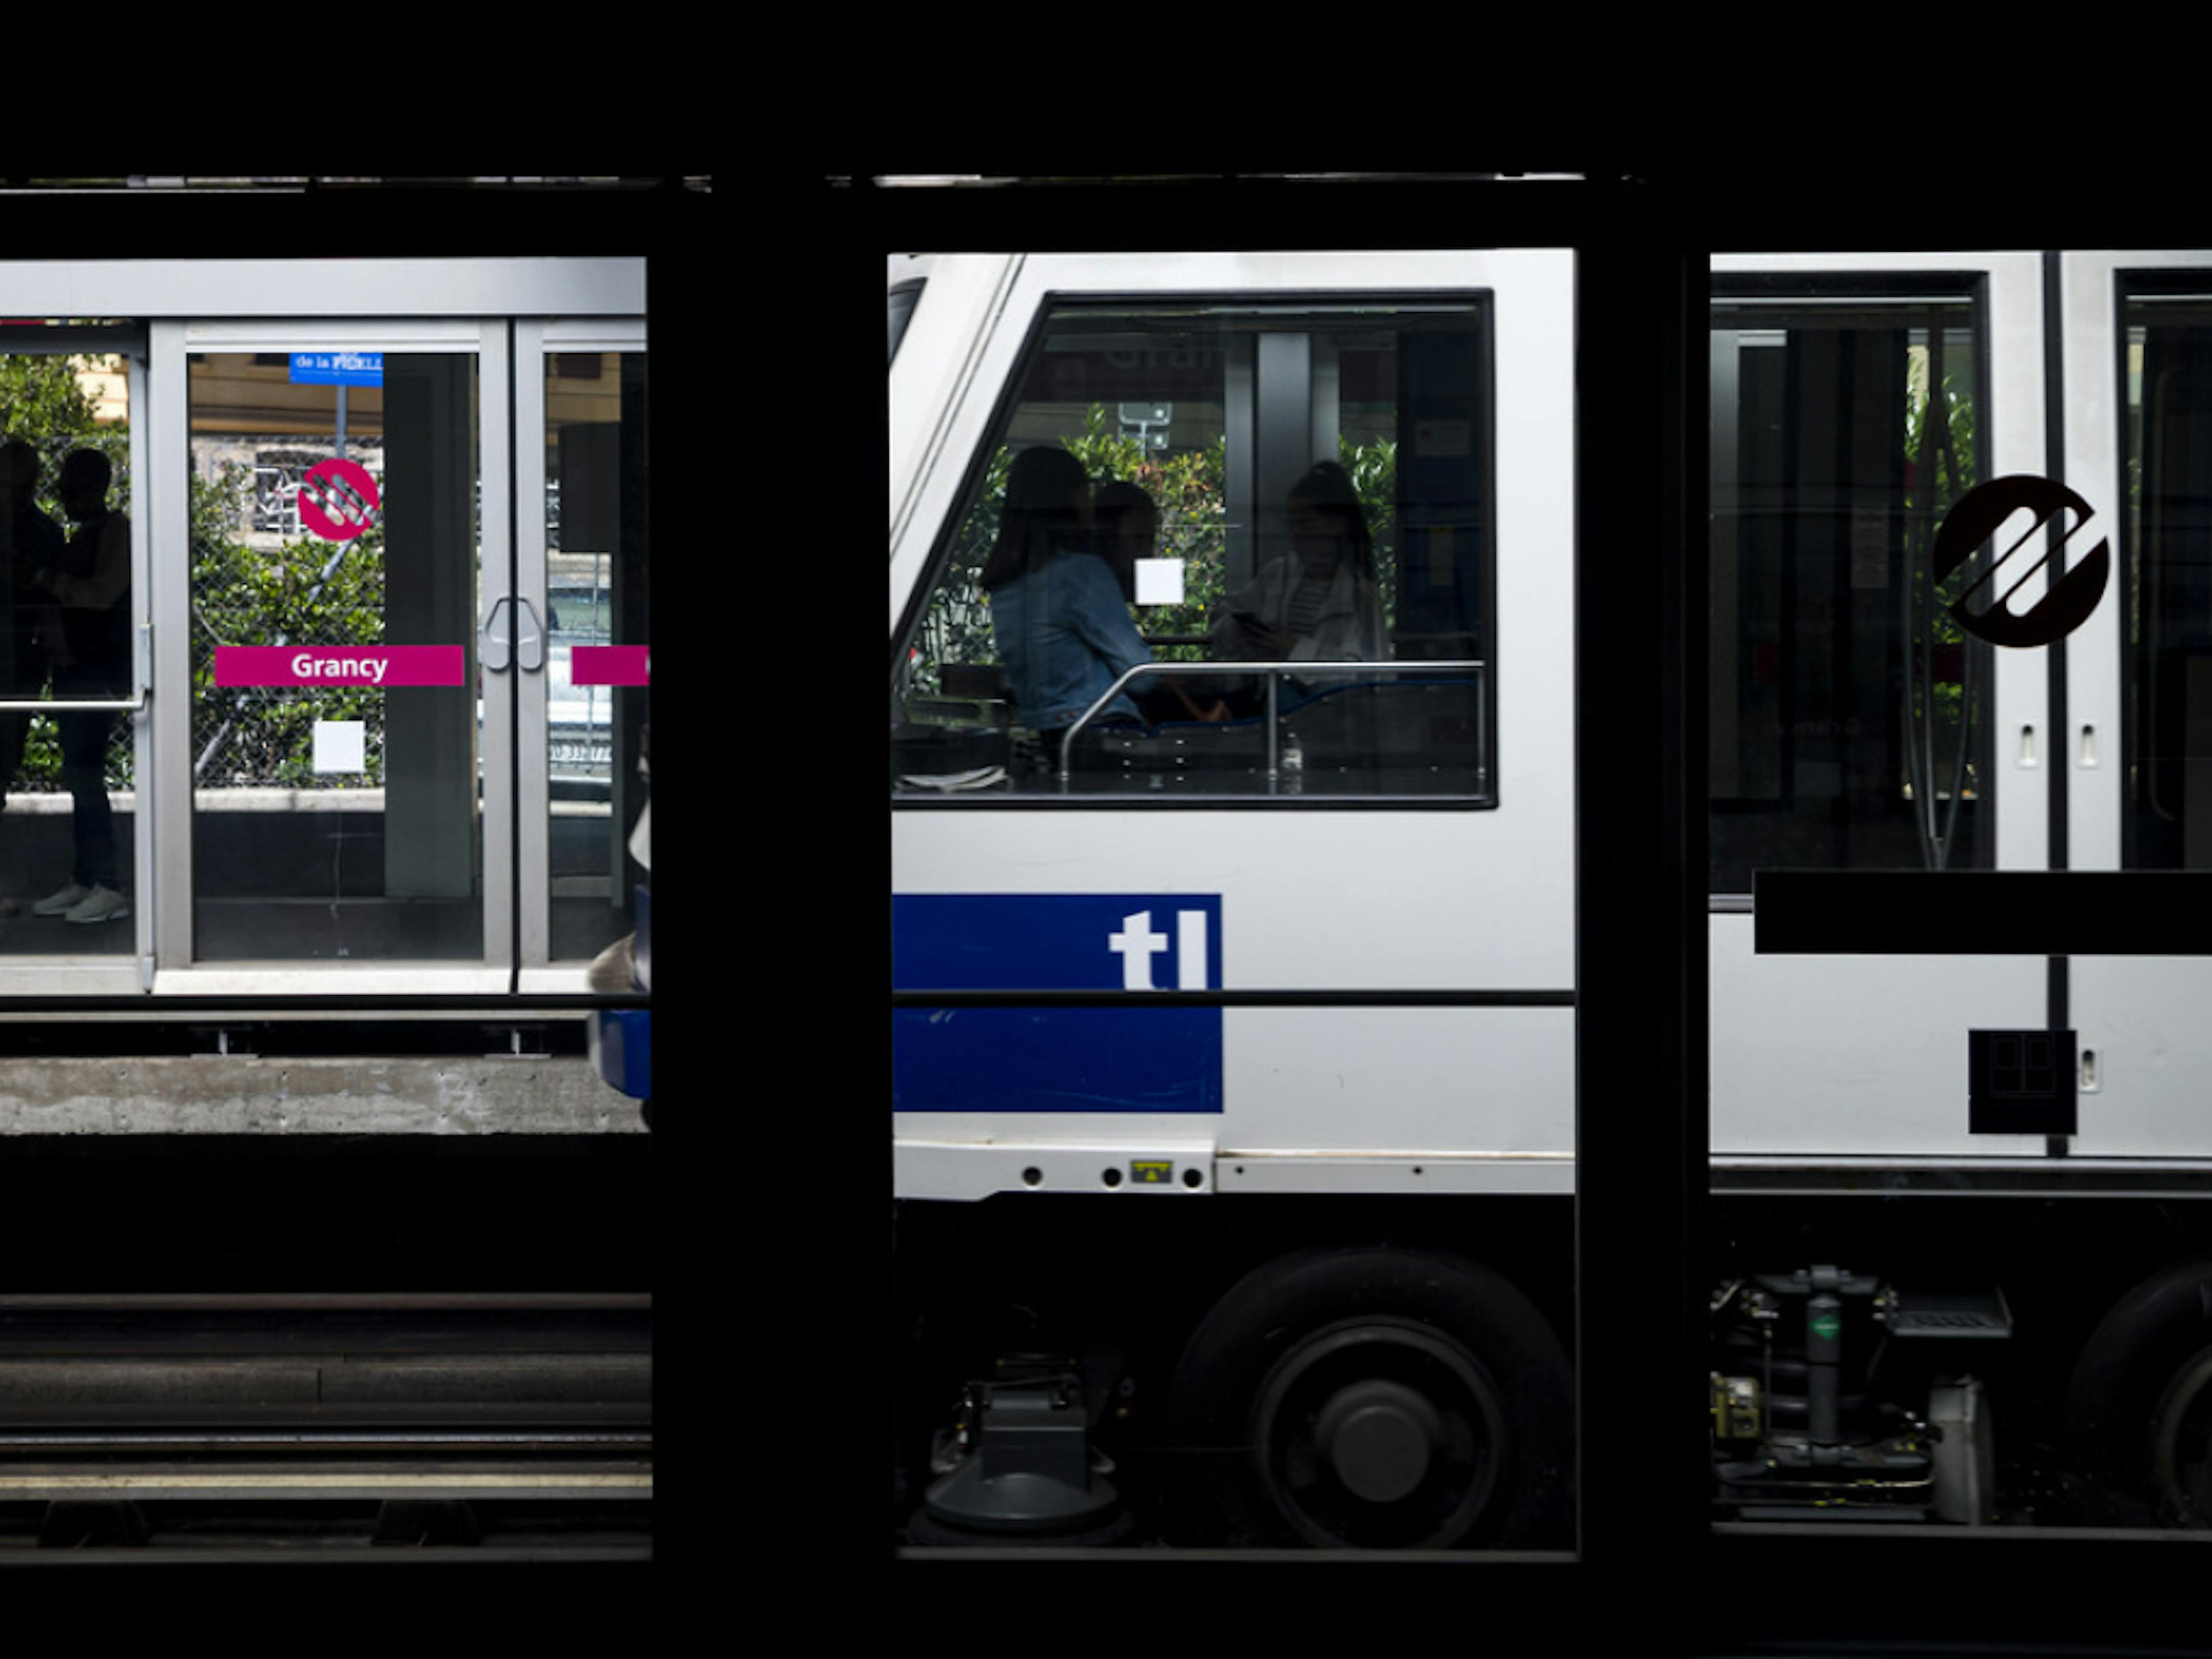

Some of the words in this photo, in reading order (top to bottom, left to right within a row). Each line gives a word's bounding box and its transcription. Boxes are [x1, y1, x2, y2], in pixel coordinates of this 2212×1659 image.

[295, 355, 313, 369] de
[317, 355, 330, 369] la
[292, 653, 388, 684] Grancy
[1108, 910, 1207, 990] tl
